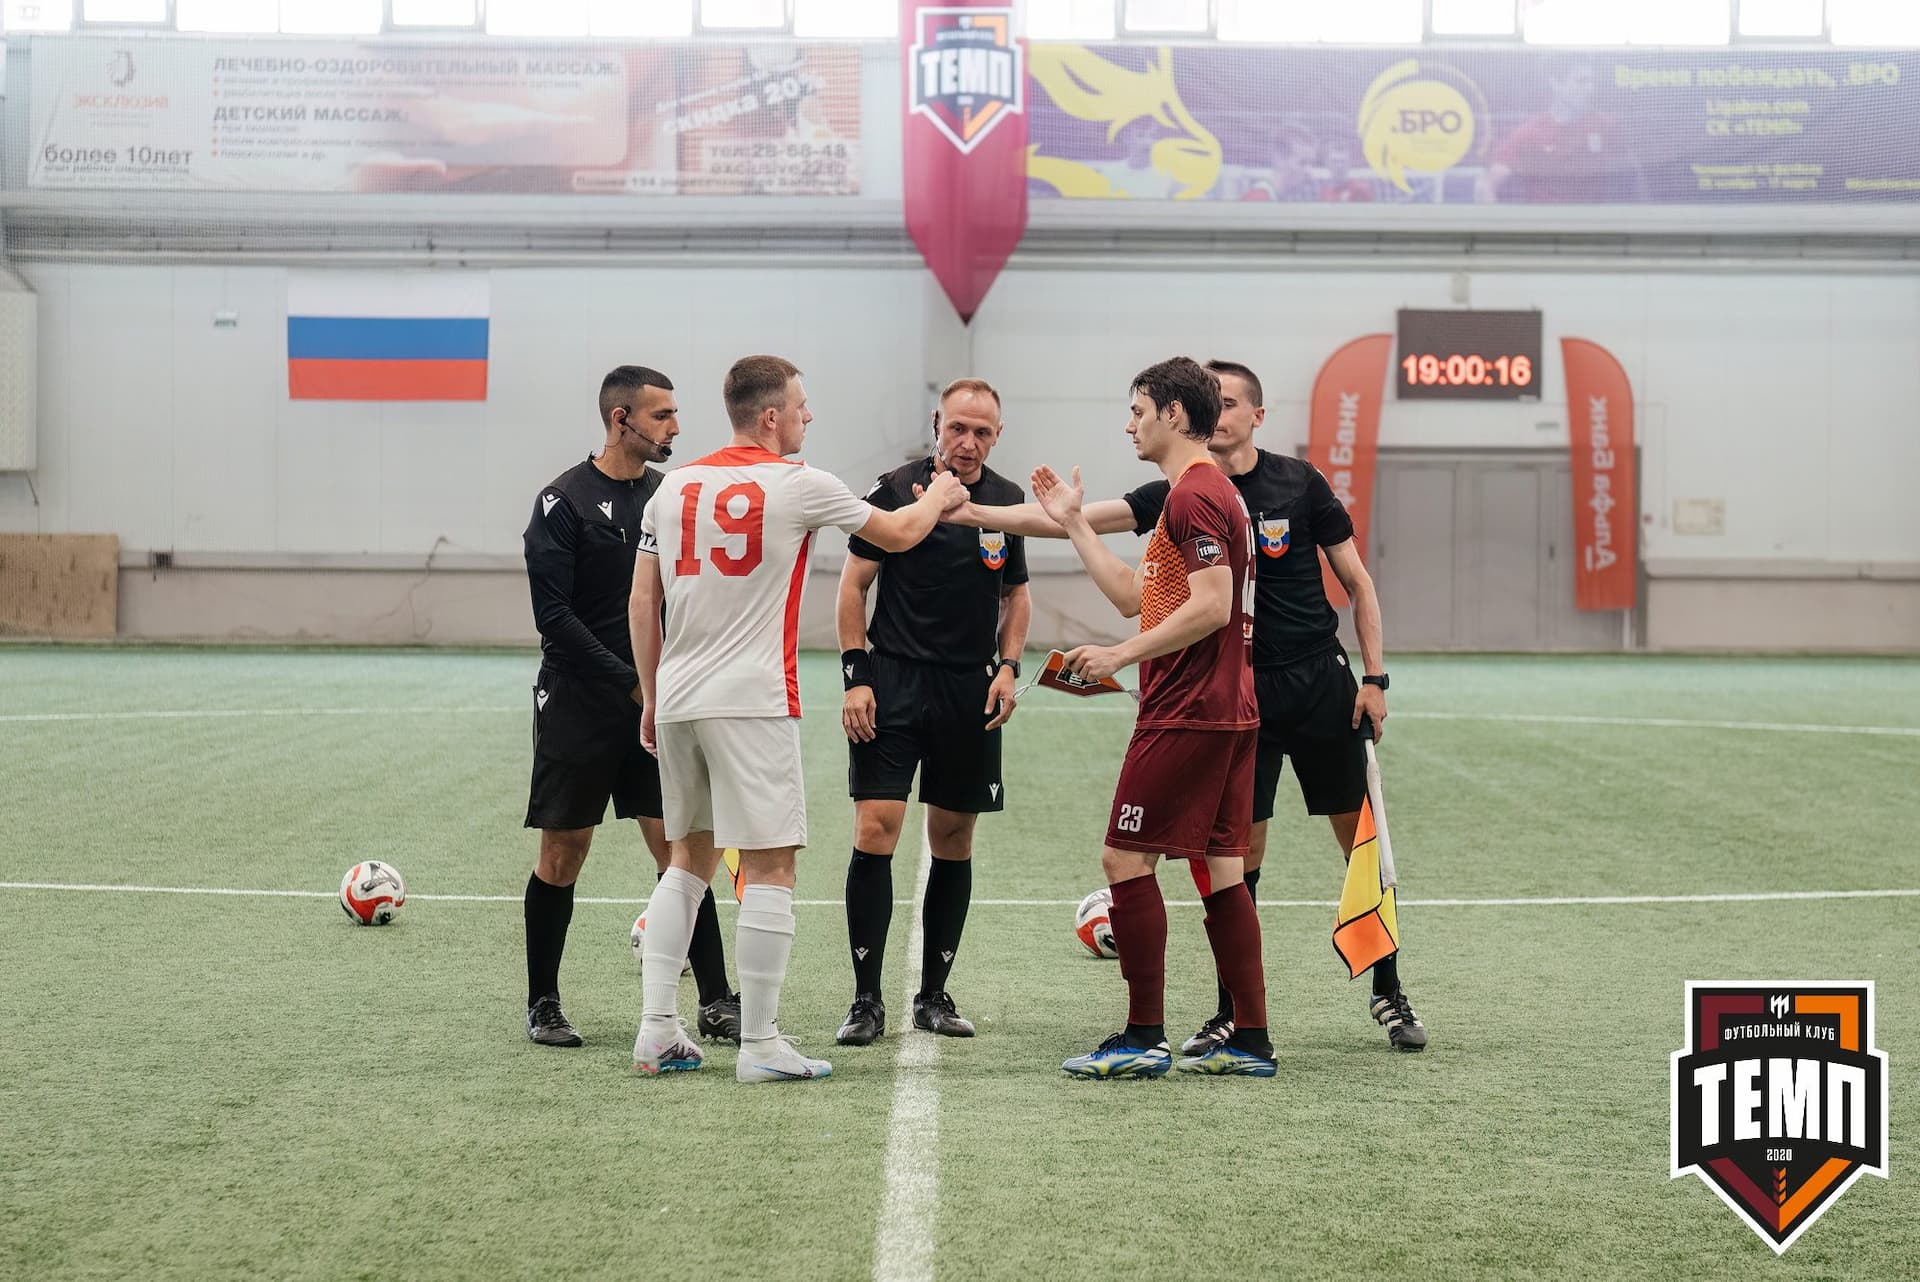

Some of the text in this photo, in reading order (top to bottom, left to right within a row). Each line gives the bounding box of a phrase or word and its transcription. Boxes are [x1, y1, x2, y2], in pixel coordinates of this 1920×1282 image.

[214, 57, 518, 76] ЛЕЧЕБНО-ОЗДОРОВИТЕЛЬНЫЙ
[920, 48, 1012, 98] ТЕМП
[213, 105, 410, 122] ДЕТСКИЙ МАССАЖ:
[1390, 109, 1462, 134] .БРО
[45, 144, 193, 165] более 10лет
[1402, 353, 1532, 387] 19:00:16
[1330, 392, 1362, 466] Банк
[675, 481, 766, 578] 19
[1198, 543, 1221, 558] ТЕМП
[1117, 803, 1144, 833] 23
